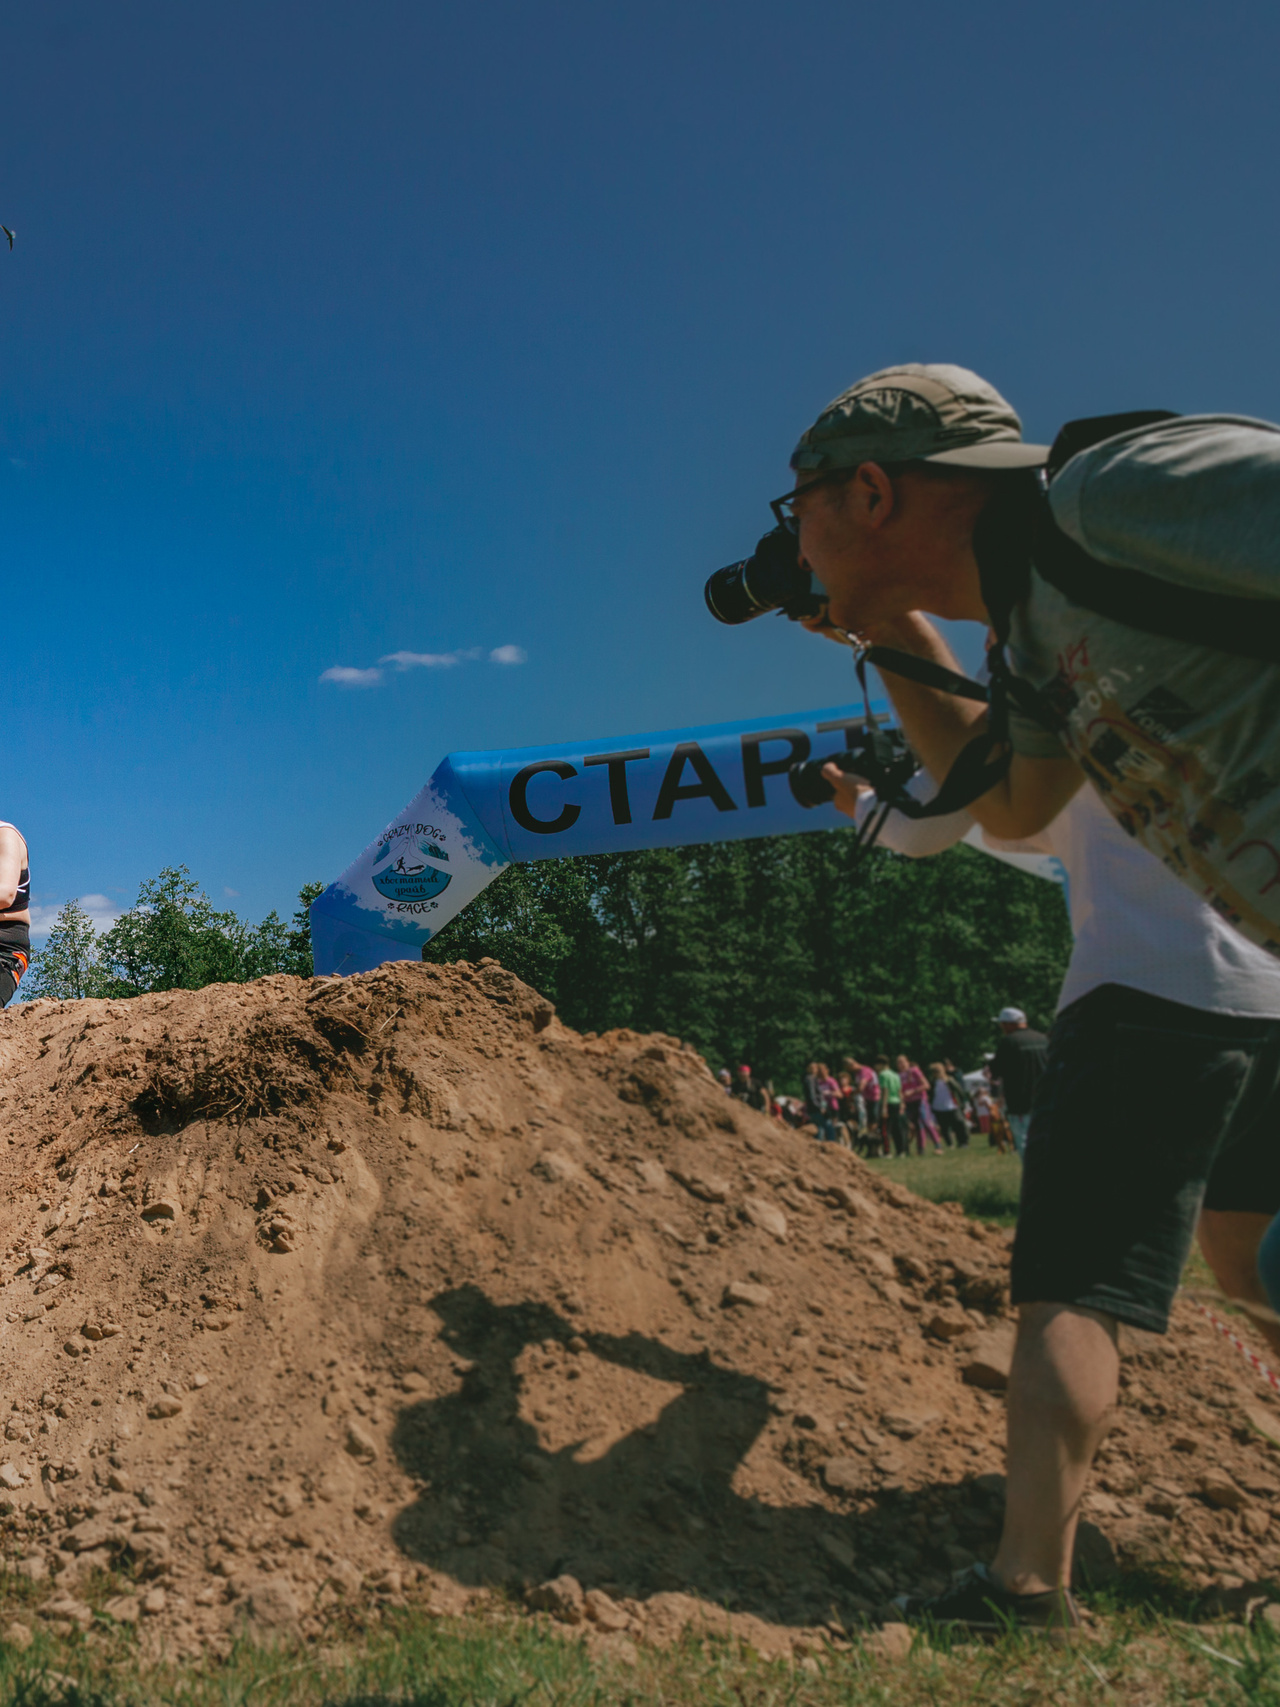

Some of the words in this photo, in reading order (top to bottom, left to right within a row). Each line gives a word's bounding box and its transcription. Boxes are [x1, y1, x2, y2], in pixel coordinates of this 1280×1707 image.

[383, 824, 411, 843] CRAZY
[415, 824, 442, 839] DOG
[396, 902, 431, 915] RACE
